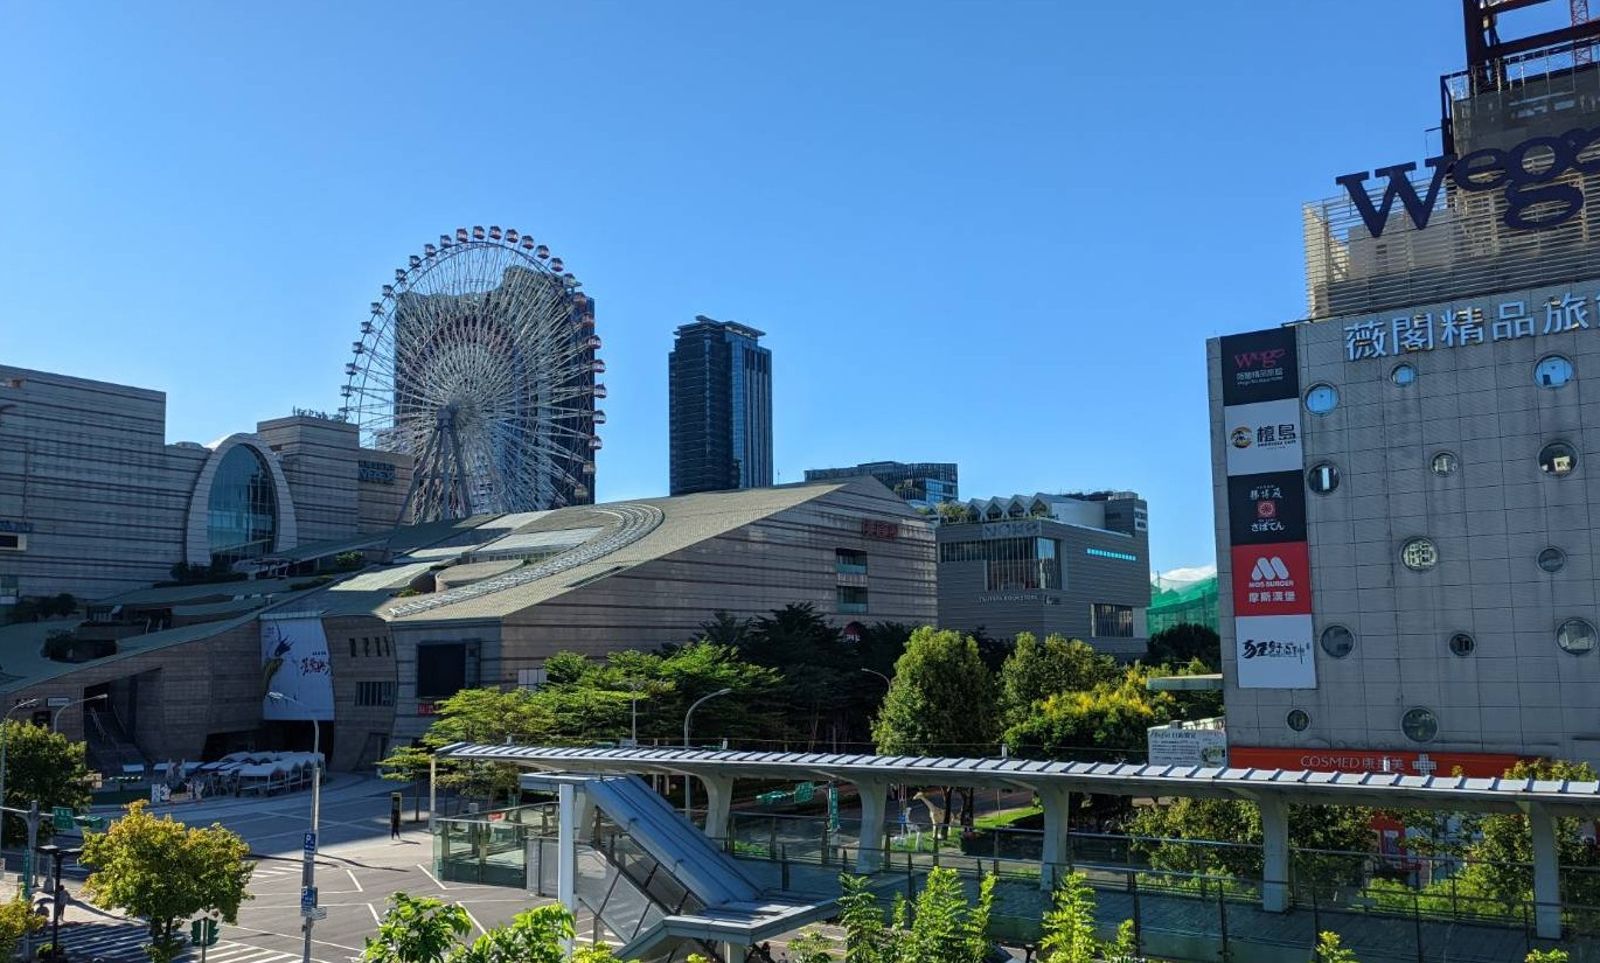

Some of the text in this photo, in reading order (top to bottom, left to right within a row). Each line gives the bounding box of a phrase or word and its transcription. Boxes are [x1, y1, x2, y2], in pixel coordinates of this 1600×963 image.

[1342, 291, 1600, 363] 薇閣精品旅
[1300, 755, 1360, 769] COSMED
